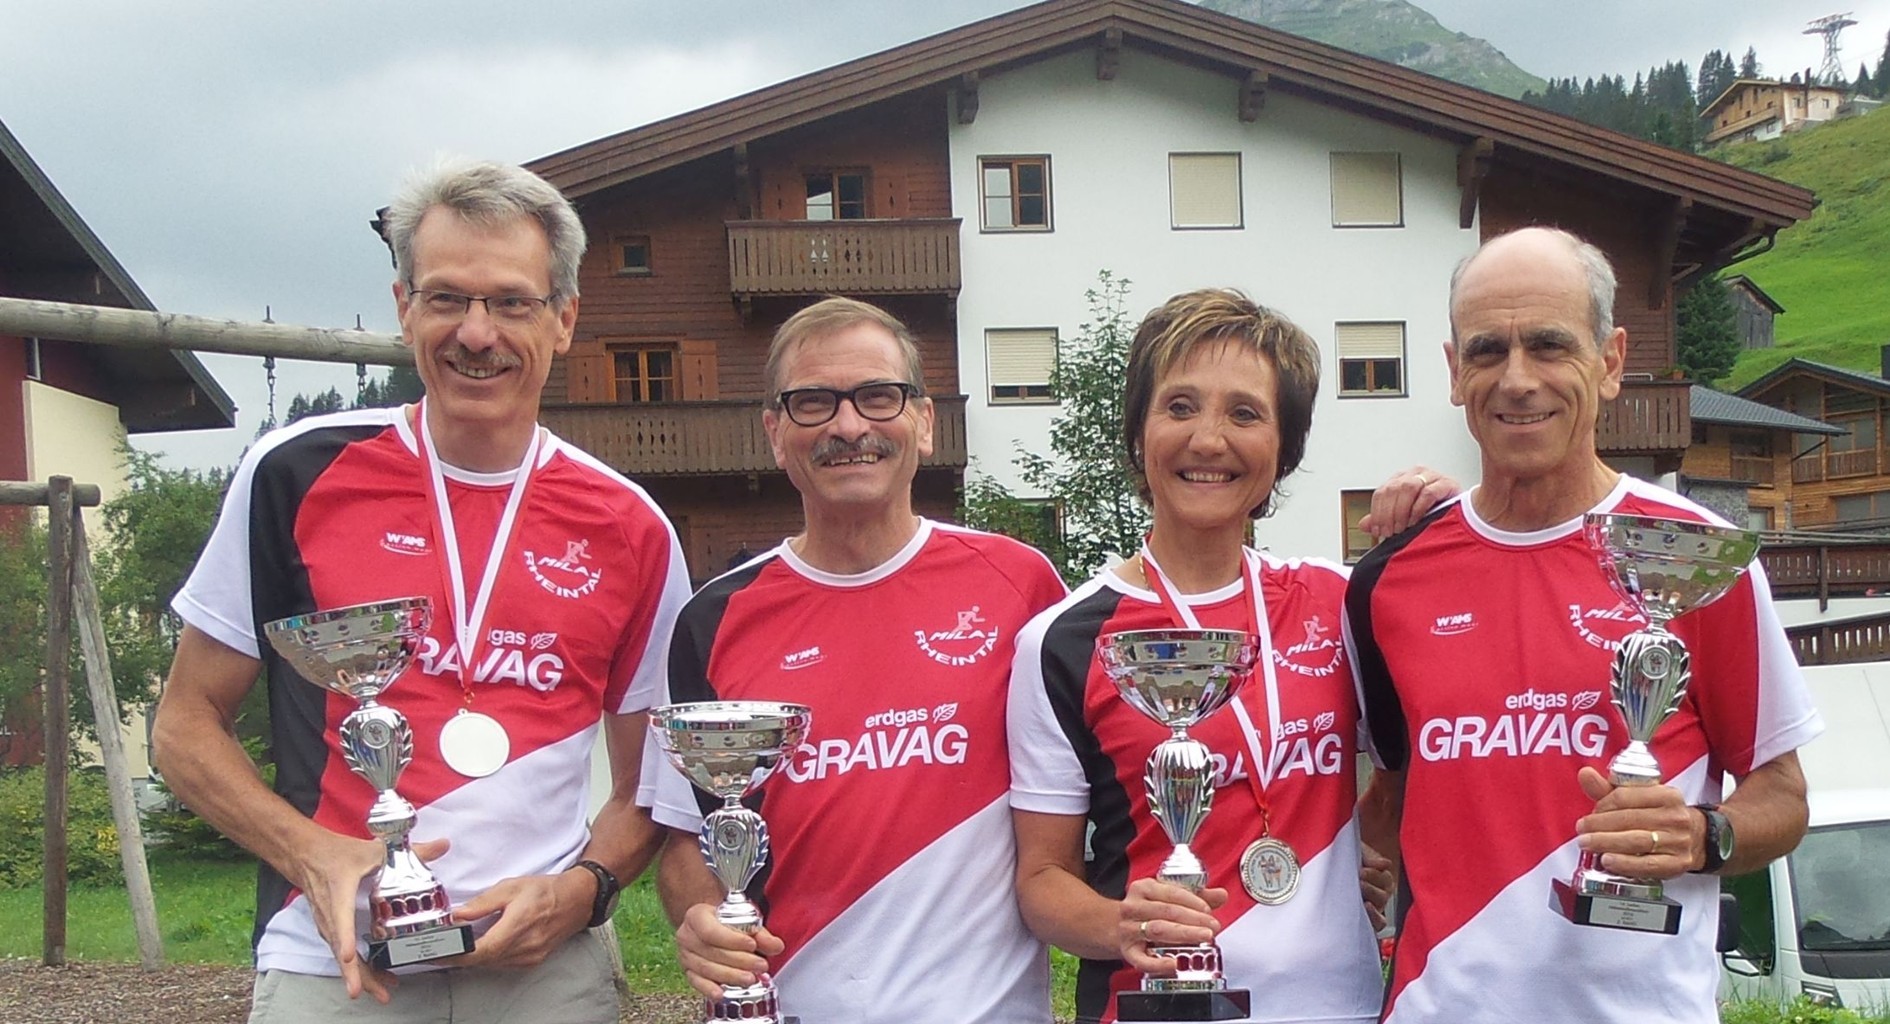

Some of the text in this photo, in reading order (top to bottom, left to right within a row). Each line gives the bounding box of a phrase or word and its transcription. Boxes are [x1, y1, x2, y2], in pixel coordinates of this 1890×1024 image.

[523, 550, 602, 599] RHEINTAL
[538, 556, 590, 576] MILA
[1583, 608, 1647, 624] MILA
[914, 625, 999, 666] RHEINTAL
[929, 629, 985, 642] MILA
[1286, 638, 1336, 657] MILA
[417, 636, 564, 692] RAVAG
[1505, 688, 1568, 711] erdgas
[864, 708, 928, 728] erdgas
[1418, 712, 1610, 762] GRAVAG
[785, 723, 970, 784] GRAVAG
